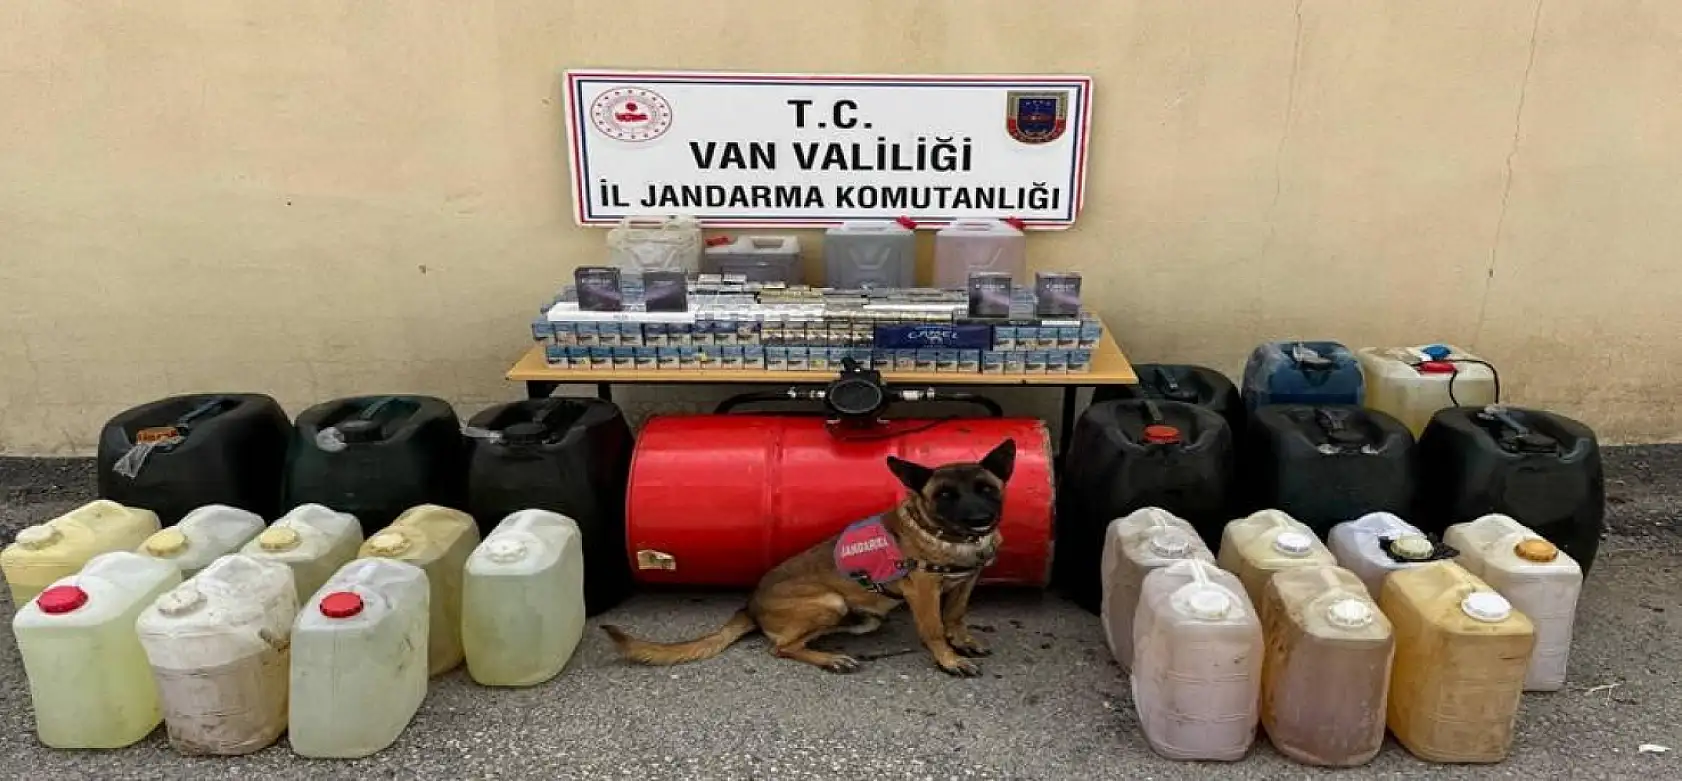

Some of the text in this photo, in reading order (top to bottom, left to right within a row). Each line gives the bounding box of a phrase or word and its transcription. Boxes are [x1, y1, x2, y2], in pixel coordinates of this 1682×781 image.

[787, 99, 874, 130] T.C.
[689, 141, 776, 171] VAN
[793, 135, 972, 174] VALİLİĞİ
[599, 178, 1060, 211] İL JANDARMA KOMUTANLIĞI
